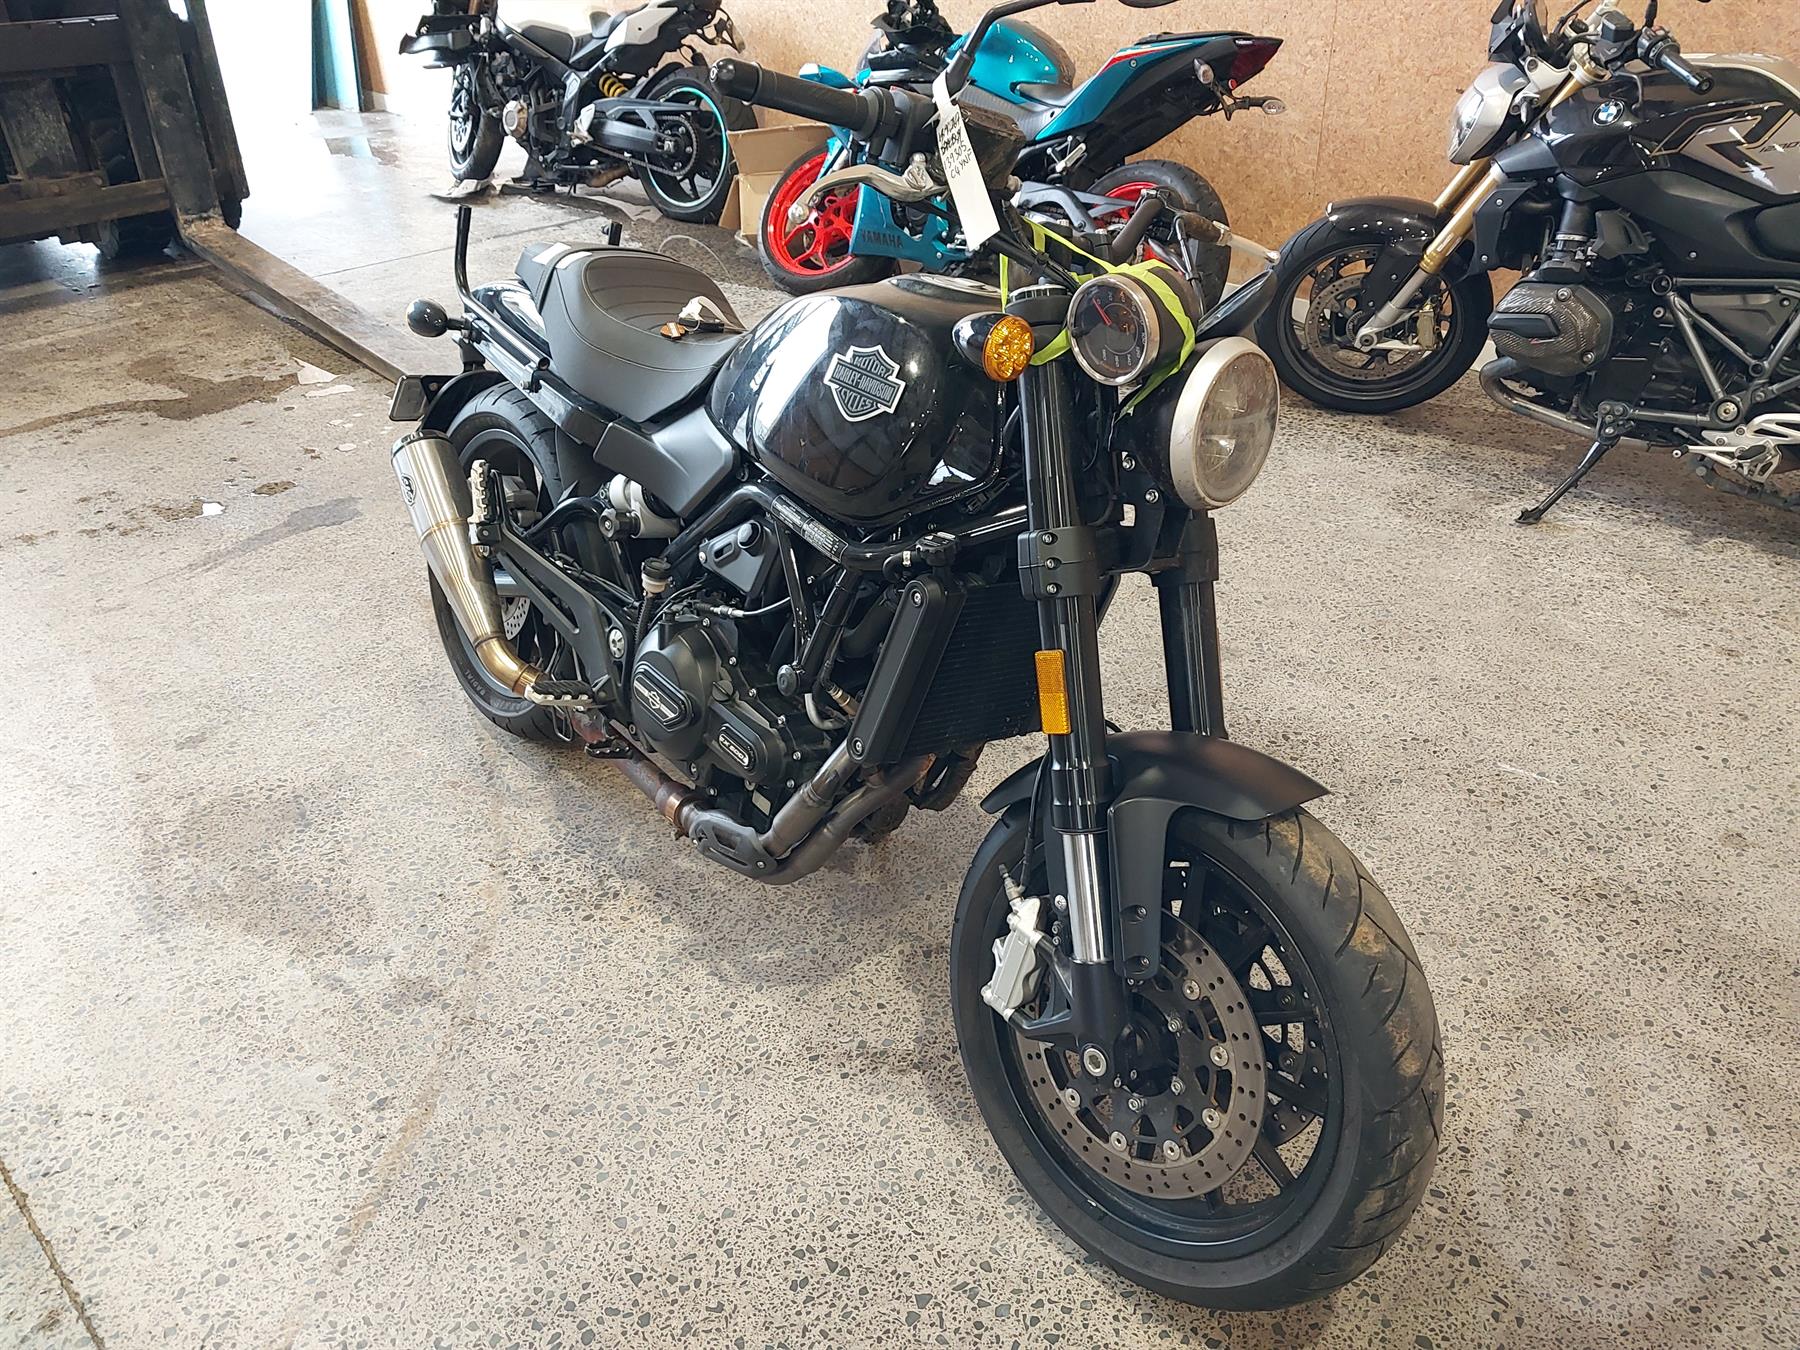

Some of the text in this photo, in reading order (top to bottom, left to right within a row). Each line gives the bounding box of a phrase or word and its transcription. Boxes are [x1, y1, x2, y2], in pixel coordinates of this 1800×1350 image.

[862, 230, 904, 248] YAMAHA
[853, 356, 887, 378] MOTOR
[832, 363, 895, 402] HARLEY-DAVIDSON
[840, 387, 873, 412] CYCLES
